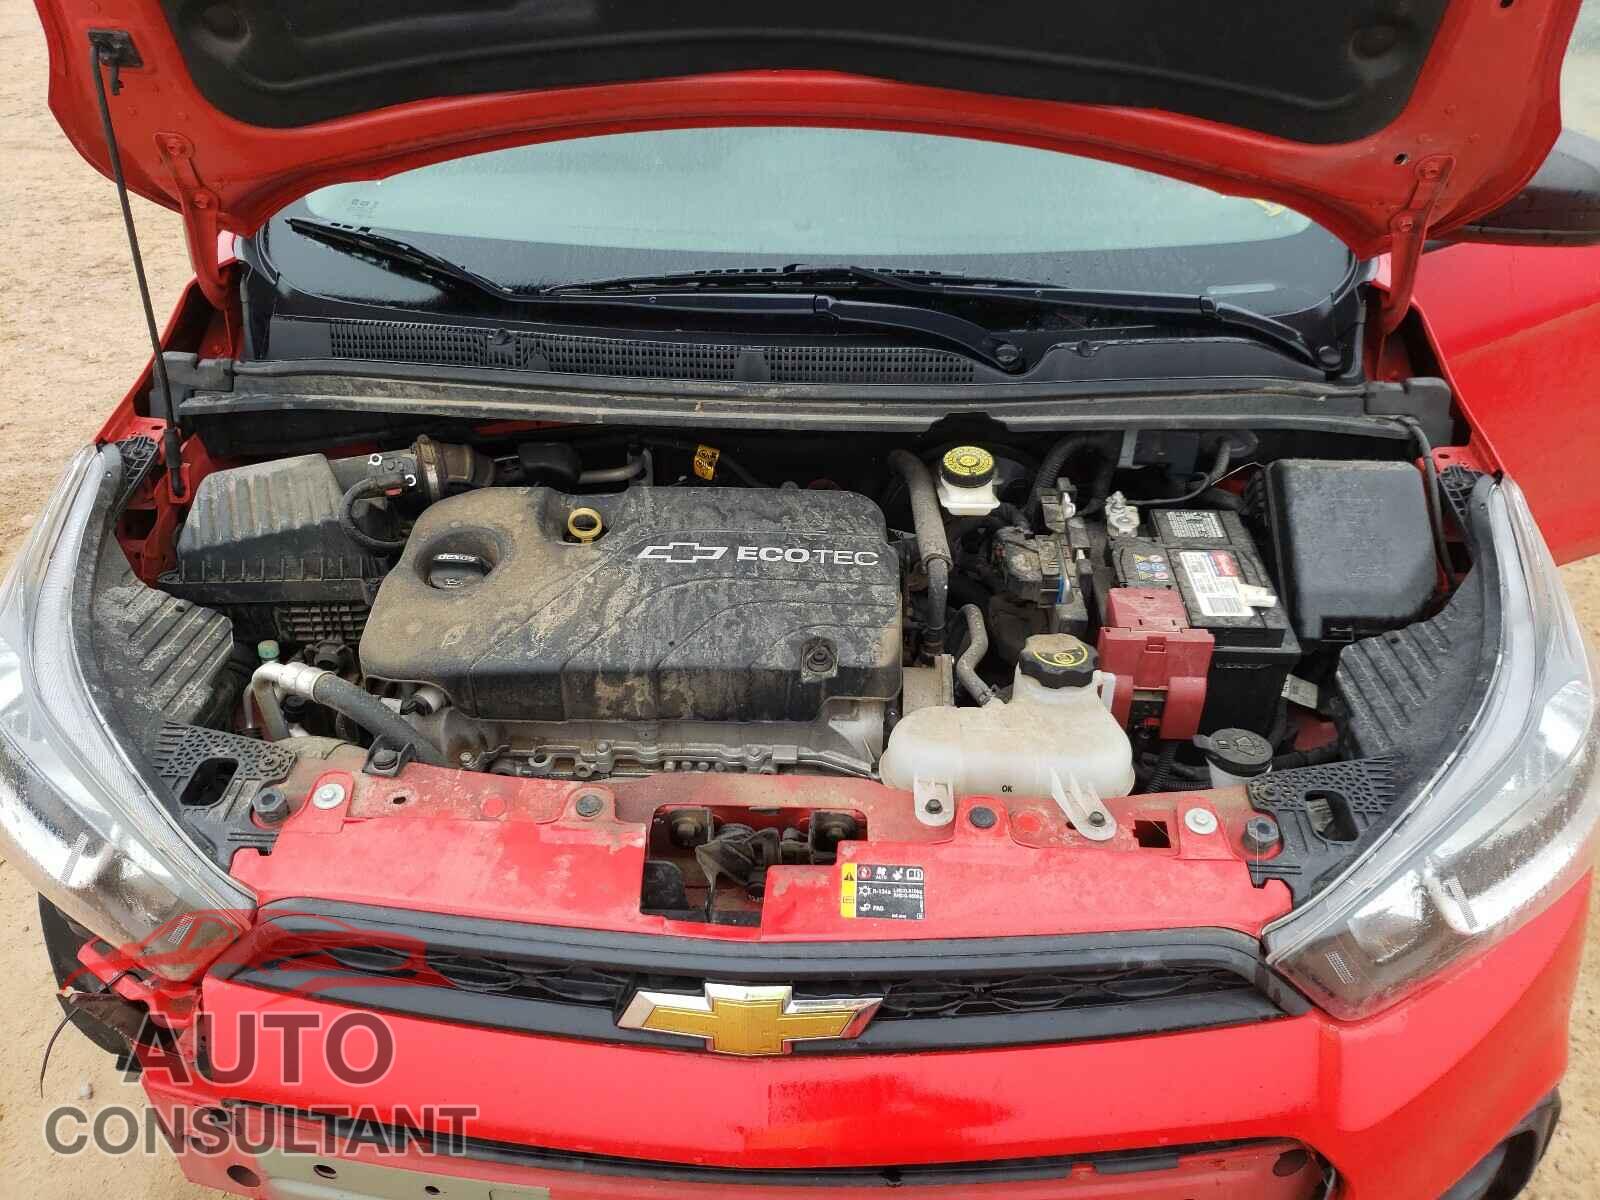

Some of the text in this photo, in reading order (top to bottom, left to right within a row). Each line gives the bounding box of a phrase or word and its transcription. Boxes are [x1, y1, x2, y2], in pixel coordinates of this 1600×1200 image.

[437, 552, 478, 562] dexos
[737, 546, 879, 566] ECOTEC
[1001, 784, 1013, 793] OK
